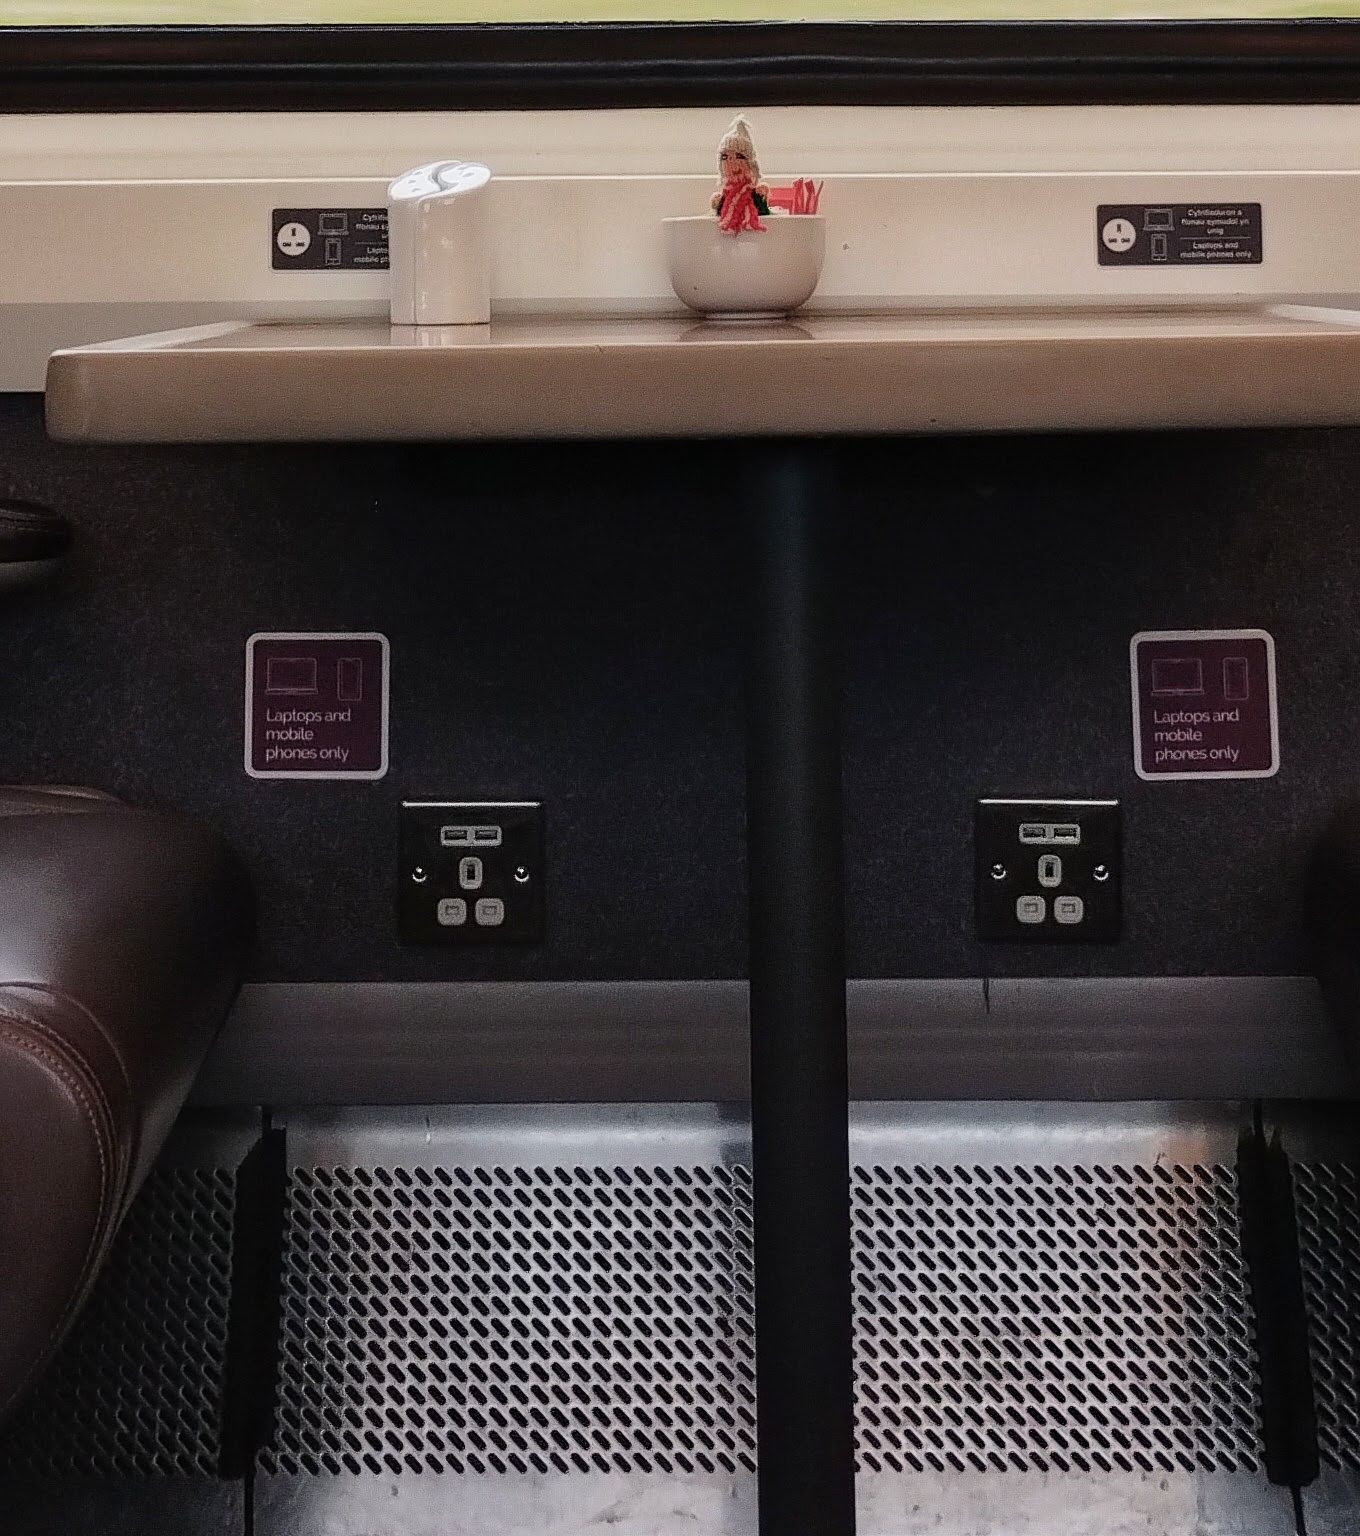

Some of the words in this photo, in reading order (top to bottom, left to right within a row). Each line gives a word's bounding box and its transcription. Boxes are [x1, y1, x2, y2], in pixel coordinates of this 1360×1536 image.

[266, 707, 322, 725] Laptops
[325, 707, 351, 722] and
[1154, 709, 1210, 725] Laptops
[1212, 707, 1239, 722] and
[266, 726, 314, 740] mobile
[1155, 728, 1203, 741] mobile
[266, 745, 317, 763] phones
[319, 745, 349, 763] only
[1155, 747, 1208, 764] phones
[1209, 745, 1239, 762] only
